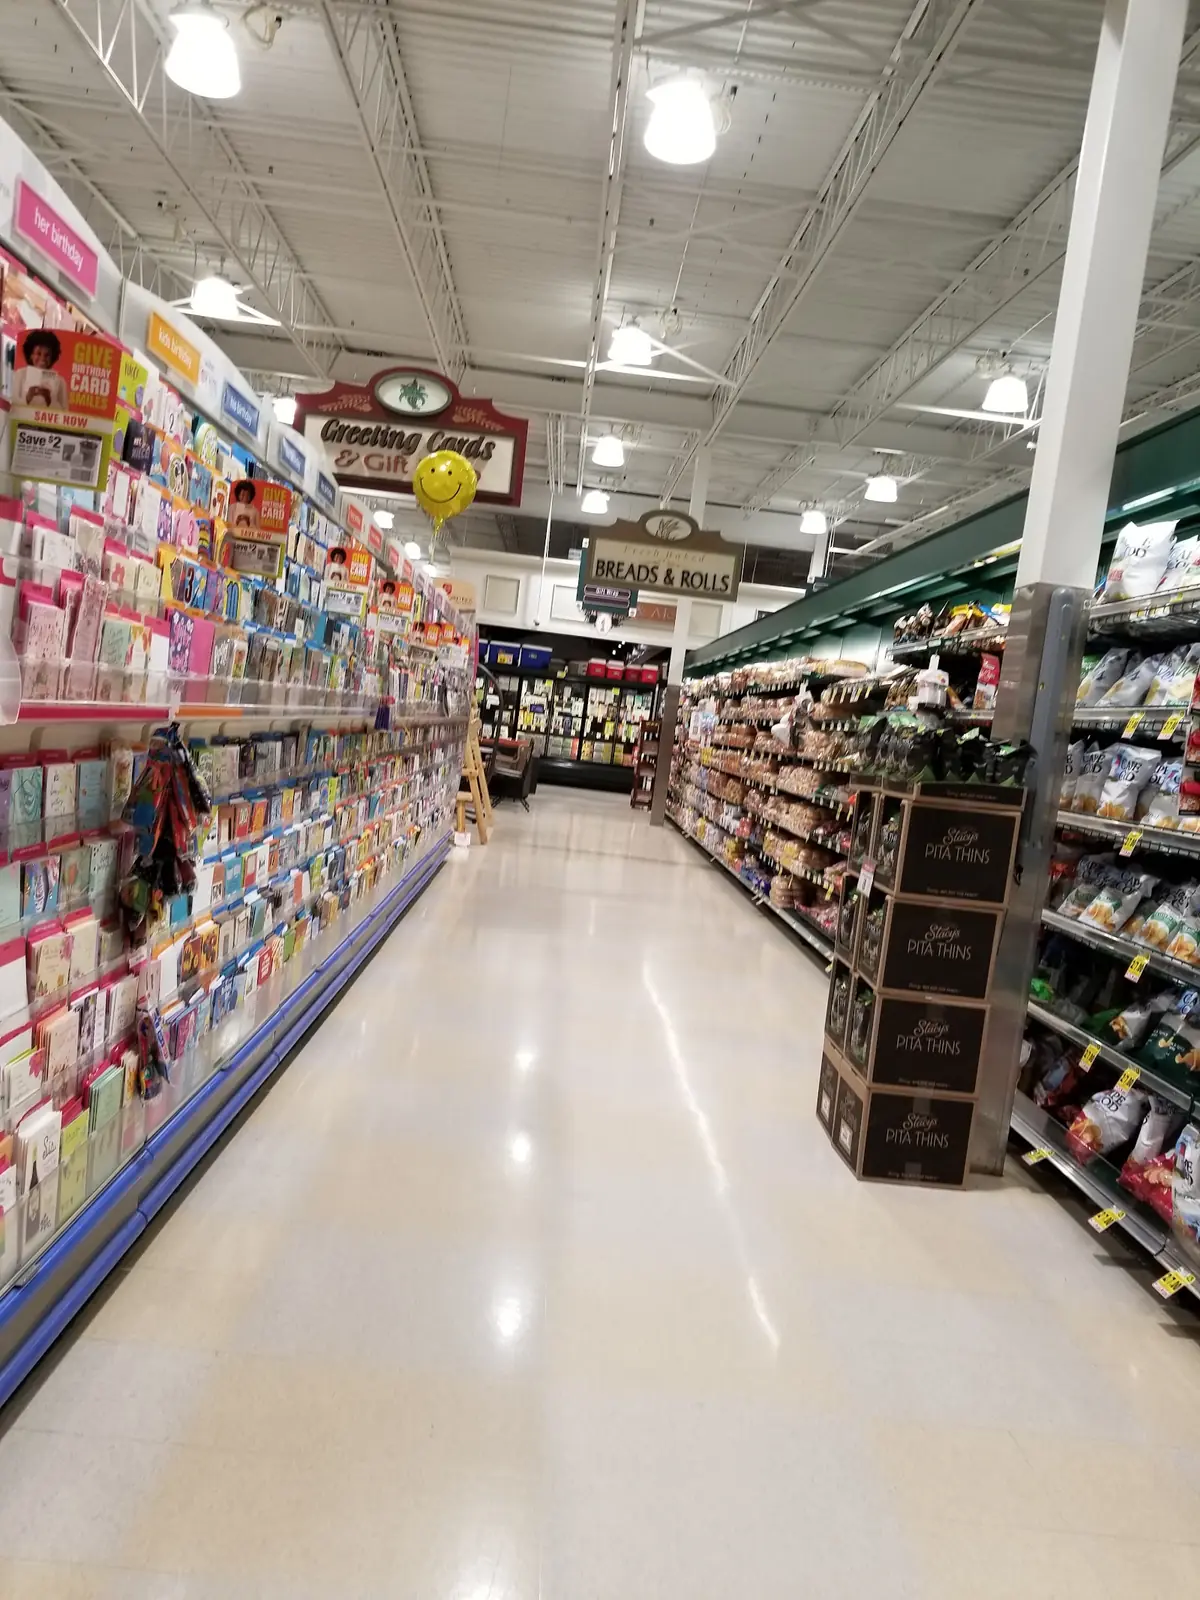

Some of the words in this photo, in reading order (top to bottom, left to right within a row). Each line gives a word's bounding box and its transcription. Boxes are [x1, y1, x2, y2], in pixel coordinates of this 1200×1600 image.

[34, 207, 51, 235] her
[51, 222, 84, 273] birthday
[73, 342, 113, 368] GIVE
[71, 362, 112, 379] BIRTHDAY
[70, 374, 110, 397] CARD
[69, 392, 109, 410] SMILES
[34, 410, 59, 424] SAVE
[63, 414, 88, 428] NOW
[18, 431, 47, 447] Save
[47, 433, 63, 450] $2
[320, 418, 423, 456] Greeting
[426, 431, 497, 461] Cards
[334, 450, 360, 468] &
[363, 454, 409, 474] Gift
[263, 487, 287, 503] GIVE
[261, 507, 285, 520] CARD
[256, 531, 273, 540] NOW
[595, 560, 659, 584] BREADS
[663, 568, 675, 586] &
[680, 570, 730, 593] ROLLS
[1121, 757, 1143, 773] CAPE
[942, 827, 979, 847] Stacy's
[925, 843, 952, 861] PITA
[954, 846, 990, 865] THINS
[925, 923, 960, 943] Stacy's
[907, 939, 934, 957] PITA
[937, 942, 972, 961] THINS
[913, 1020, 949, 1037] Stacy's
[896, 1034, 922, 1052] PITA
[926, 1037, 961, 1056] THINS
[1101, 1096, 1119, 1112] OD
[902, 1112, 938, 1130] Stacy's
[885, 1128, 912, 1146] PITA
[916, 1131, 949, 1149] THINS
